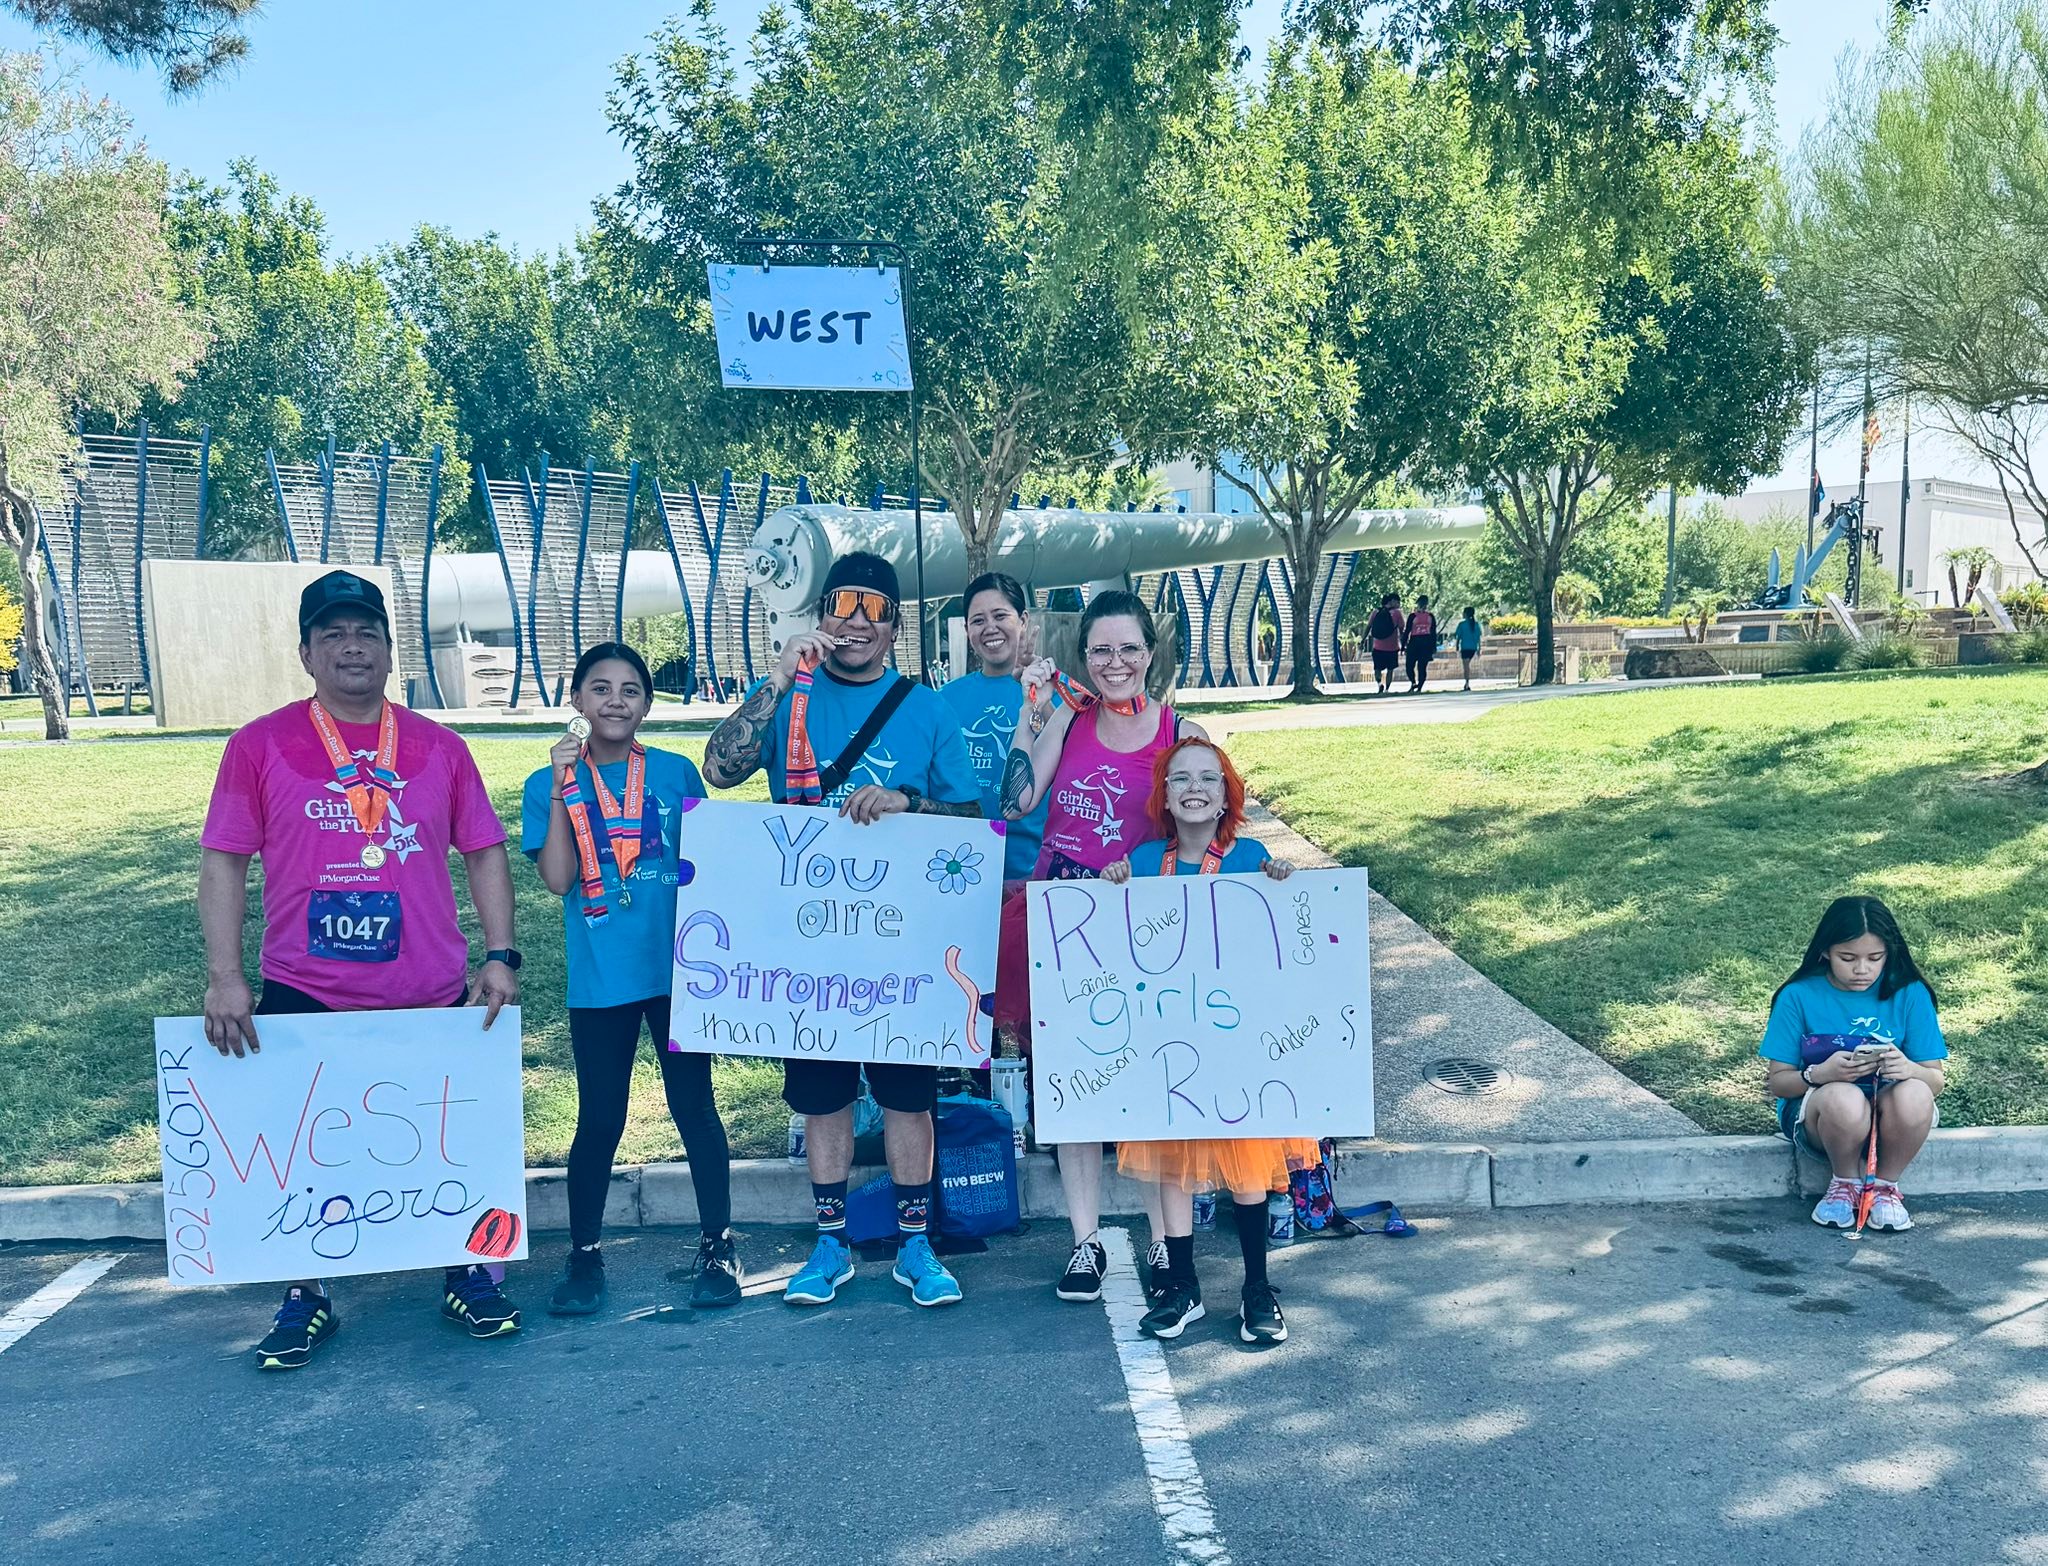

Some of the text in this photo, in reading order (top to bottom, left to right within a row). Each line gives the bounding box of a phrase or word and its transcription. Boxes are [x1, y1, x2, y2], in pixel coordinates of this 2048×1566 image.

[747, 309, 872, 345] WEST
[795, 697, 805, 719] Girls
[311, 701, 324, 721] Girls
[328, 736, 340, 754] Run
[386, 712, 394, 728] Run
[382, 745, 392, 765] Girls
[792, 739, 800, 756] Run
[970, 757, 993, 769] un
[602, 789, 611, 806] Run
[629, 791, 638, 806] Run
[1057, 790, 1092, 808] Girls
[304, 799, 356, 820] Girl
[1069, 805, 1100, 821] run
[319, 821, 339, 831] the
[578, 816, 586, 835] Run
[1102, 824, 1120, 838] 5K
[393, 833, 417, 852] 5K
[763, 815, 889, 892] You
[326, 861, 360, 871] presented
[319, 873, 380, 884] JPMorganChase
[319, 914, 391, 940] 1047
[797, 898, 903, 938] are
[1133, 907, 1182, 948] Olive
[1292, 890, 1317, 966] Genesis
[674, 910, 934, 1017] Stronger
[1062, 971, 1120, 1004] Lainie
[1077, 972, 1241, 1056] girls
[693, 1008, 963, 1061] than You Think
[1070, 1046, 1138, 1102] Madison
[1152, 1041, 1298, 1126] Run
[942, 1171, 1004, 1188] five BELOW
